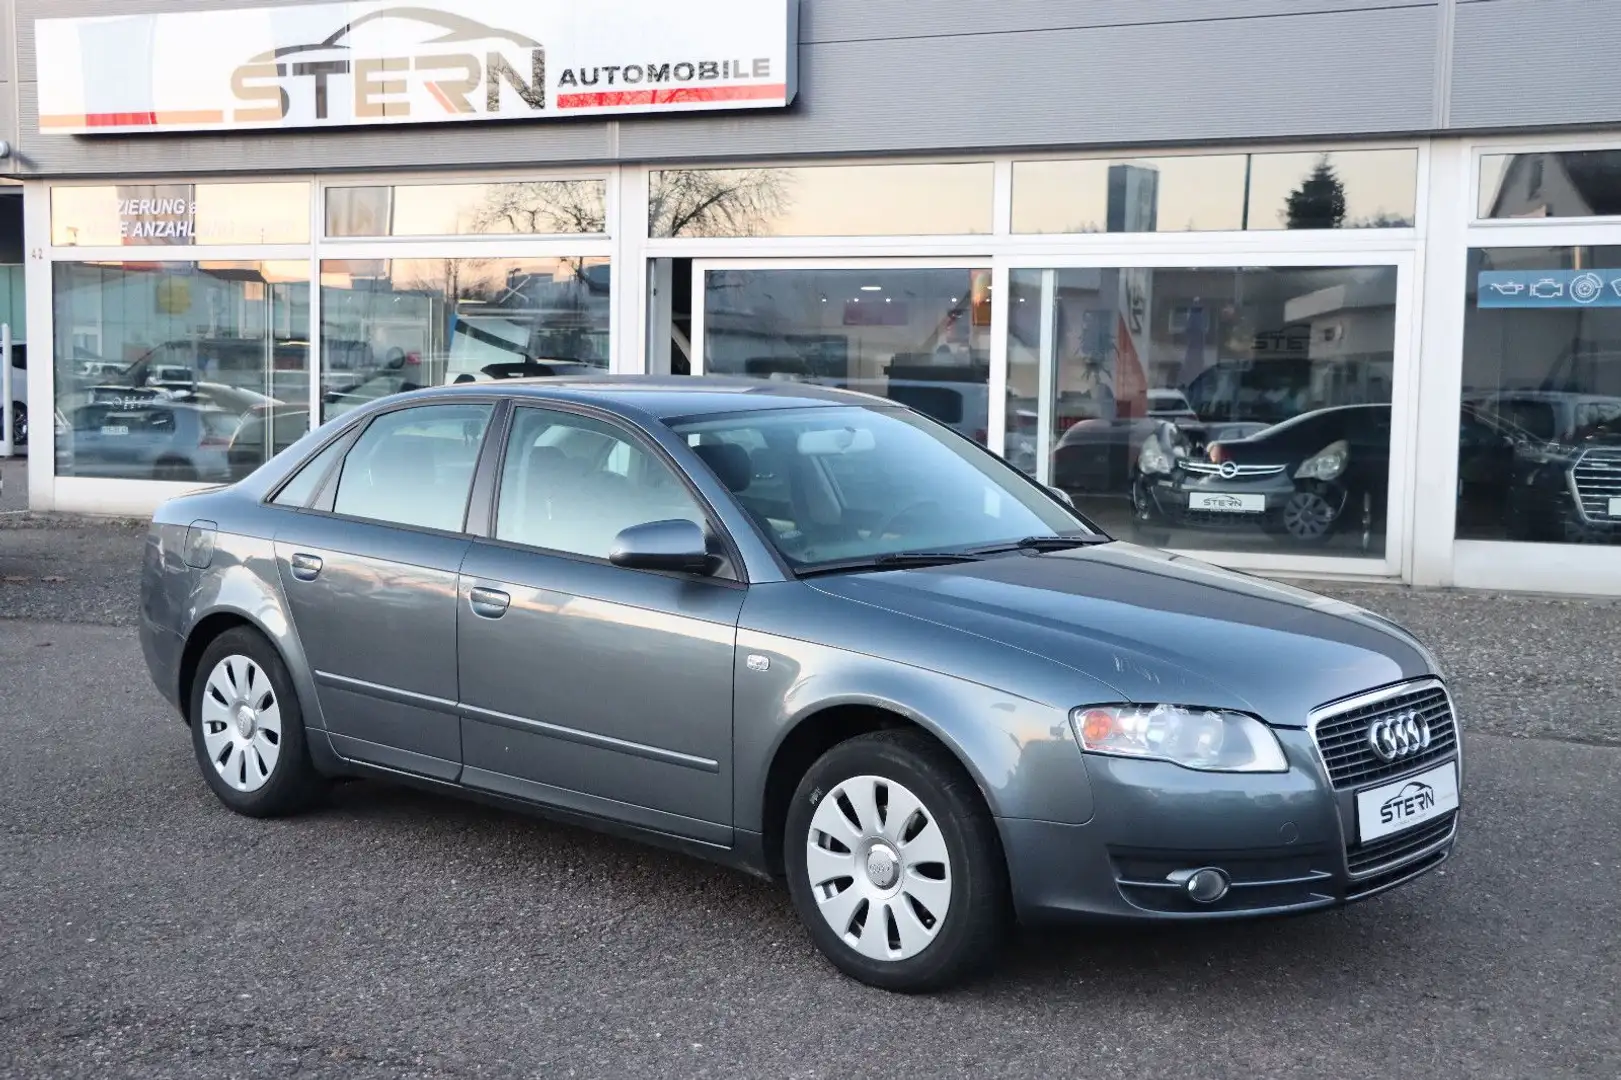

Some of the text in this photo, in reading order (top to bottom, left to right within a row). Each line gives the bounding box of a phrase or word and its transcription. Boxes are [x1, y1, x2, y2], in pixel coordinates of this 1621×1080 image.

[230, 49, 771, 122] STERN AUTOMOBILE
[1203, 499, 1242, 507] STERN
[1380, 791, 1435, 824] STERN
